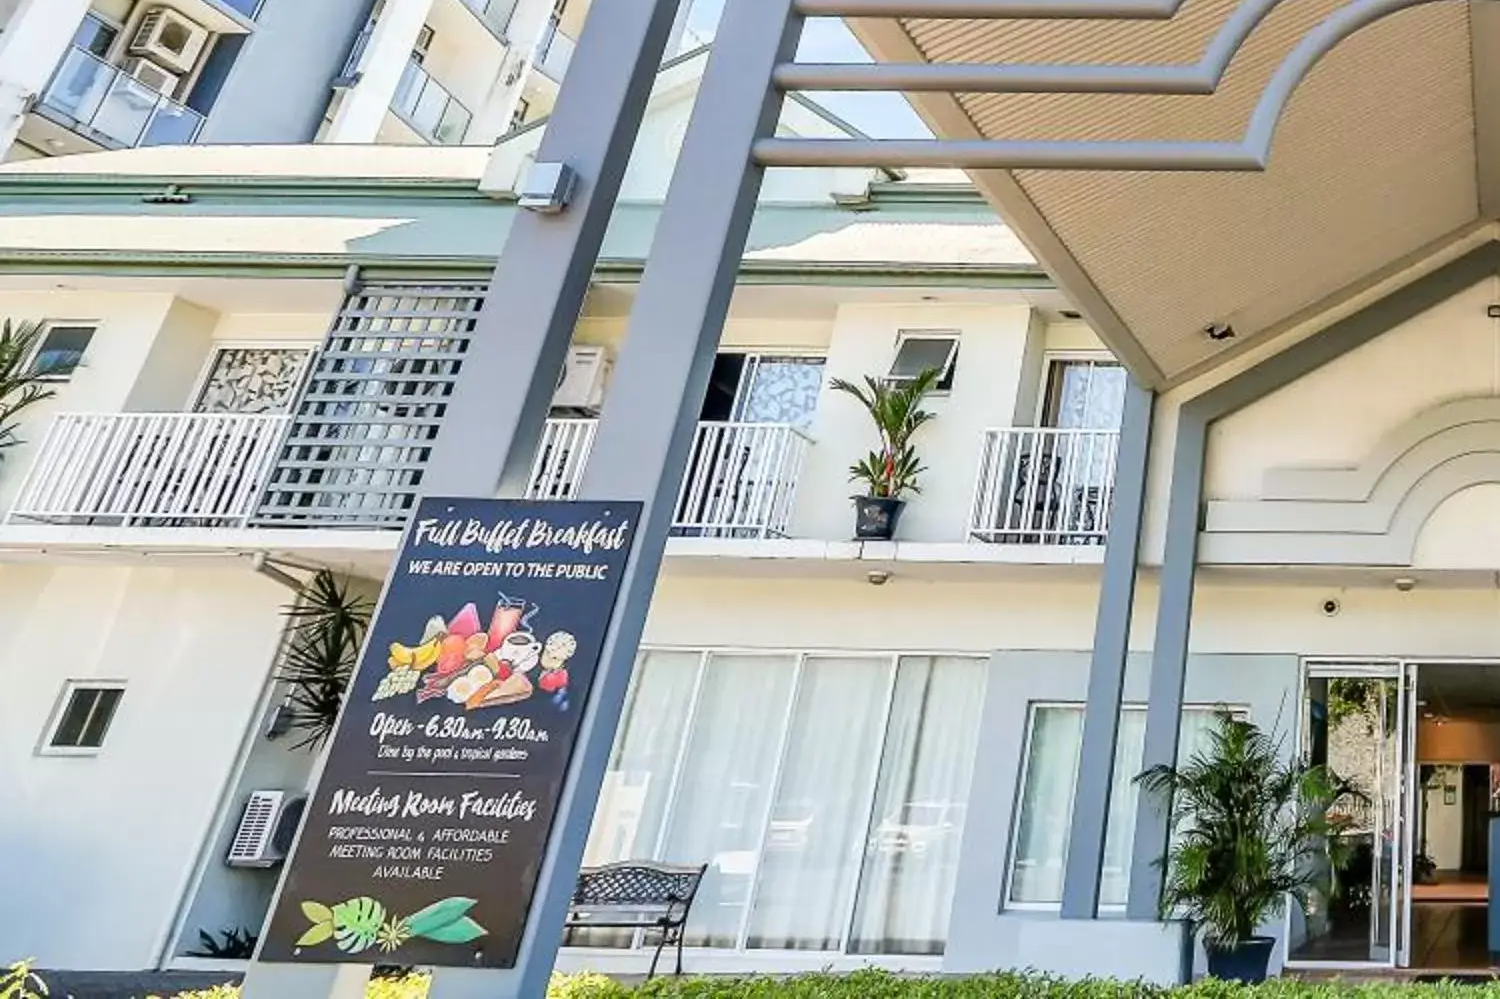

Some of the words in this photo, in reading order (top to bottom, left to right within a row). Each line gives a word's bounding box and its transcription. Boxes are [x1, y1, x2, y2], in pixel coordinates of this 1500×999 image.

[414, 518, 462, 546] Full
[460, 518, 530, 552] Buffet
[526, 518, 629, 554] Breakfast
[408, 560, 431, 574] WE
[431, 561, 462, 576] ARE
[462, 561, 503, 577] OPEN
[504, 562, 525, 577] TO
[526, 562, 555, 578] THE
[555, 564, 609, 580] PUBLIC
[369, 712, 414, 743] Open
[377, 744, 400, 758] Dine
[401, 745, 415, 761] by
[416, 745, 432, 759] the
[431, 745, 455, 763] pool
[460, 747, 493, 761] tropical
[328, 787, 401, 818] Meeting
[401, 790, 456, 818] Room
[458, 790, 537, 821] Facilities
[328, 826, 413, 841] PROFESSIONAL
[431, 828, 511, 844] AFFORDABLE
[329, 844, 385, 858] MEETING
[386, 846, 422, 860] ROOM
[426, 847, 494, 862] FACILITIES
[371, 865, 446, 880] AVAILABLE
